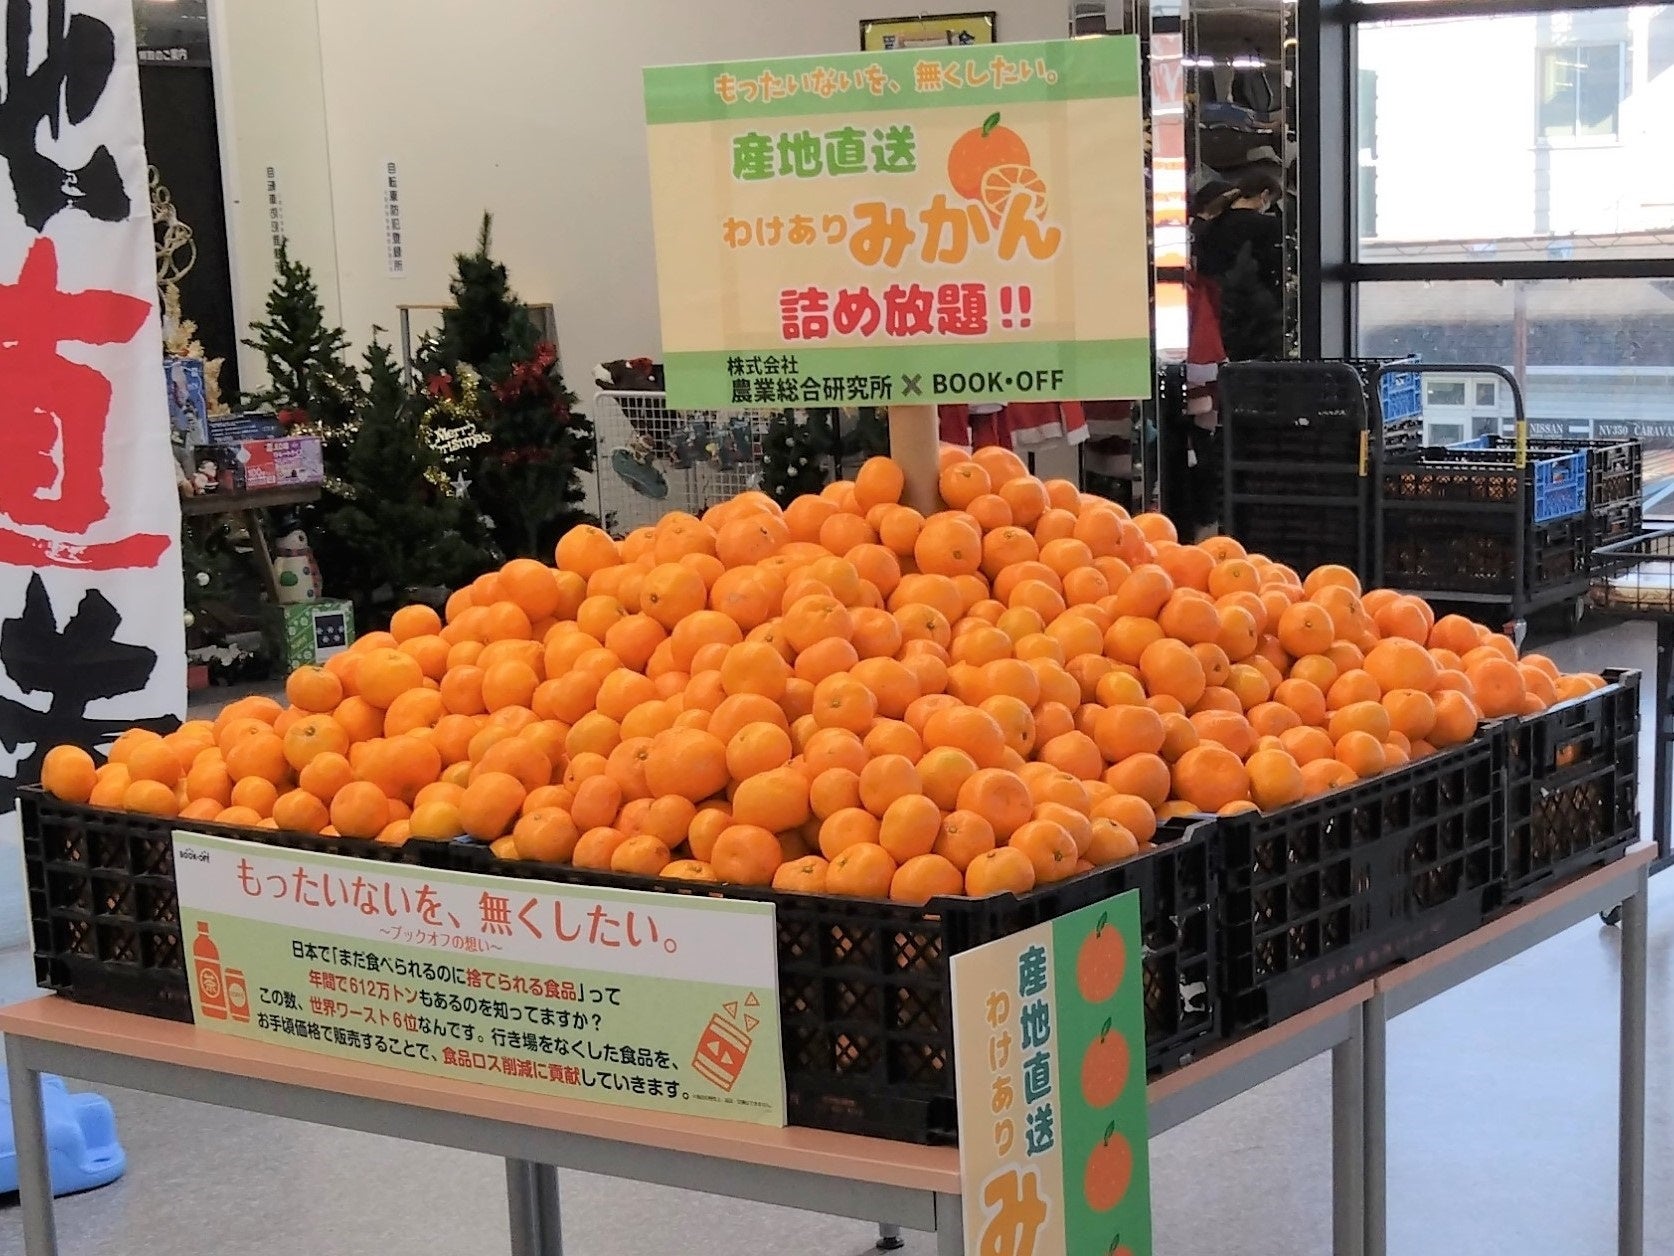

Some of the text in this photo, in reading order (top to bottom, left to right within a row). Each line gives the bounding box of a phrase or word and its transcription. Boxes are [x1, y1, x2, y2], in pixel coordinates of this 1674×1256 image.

[714, 56, 1059, 103] もったいないを、無くしたい。
[732, 126, 917, 180] 産地直送
[728, 355, 799, 376] 株式会社
[731, 375, 893, 404] 農業総合研究所
[1529, 423, 1563, 434] NISSAN
[1634, 424, 1674, 437] CARAVA
[236, 858, 678, 954] もったいないを、無くしたい。
[1019, 945, 1055, 1158] 産地直送
